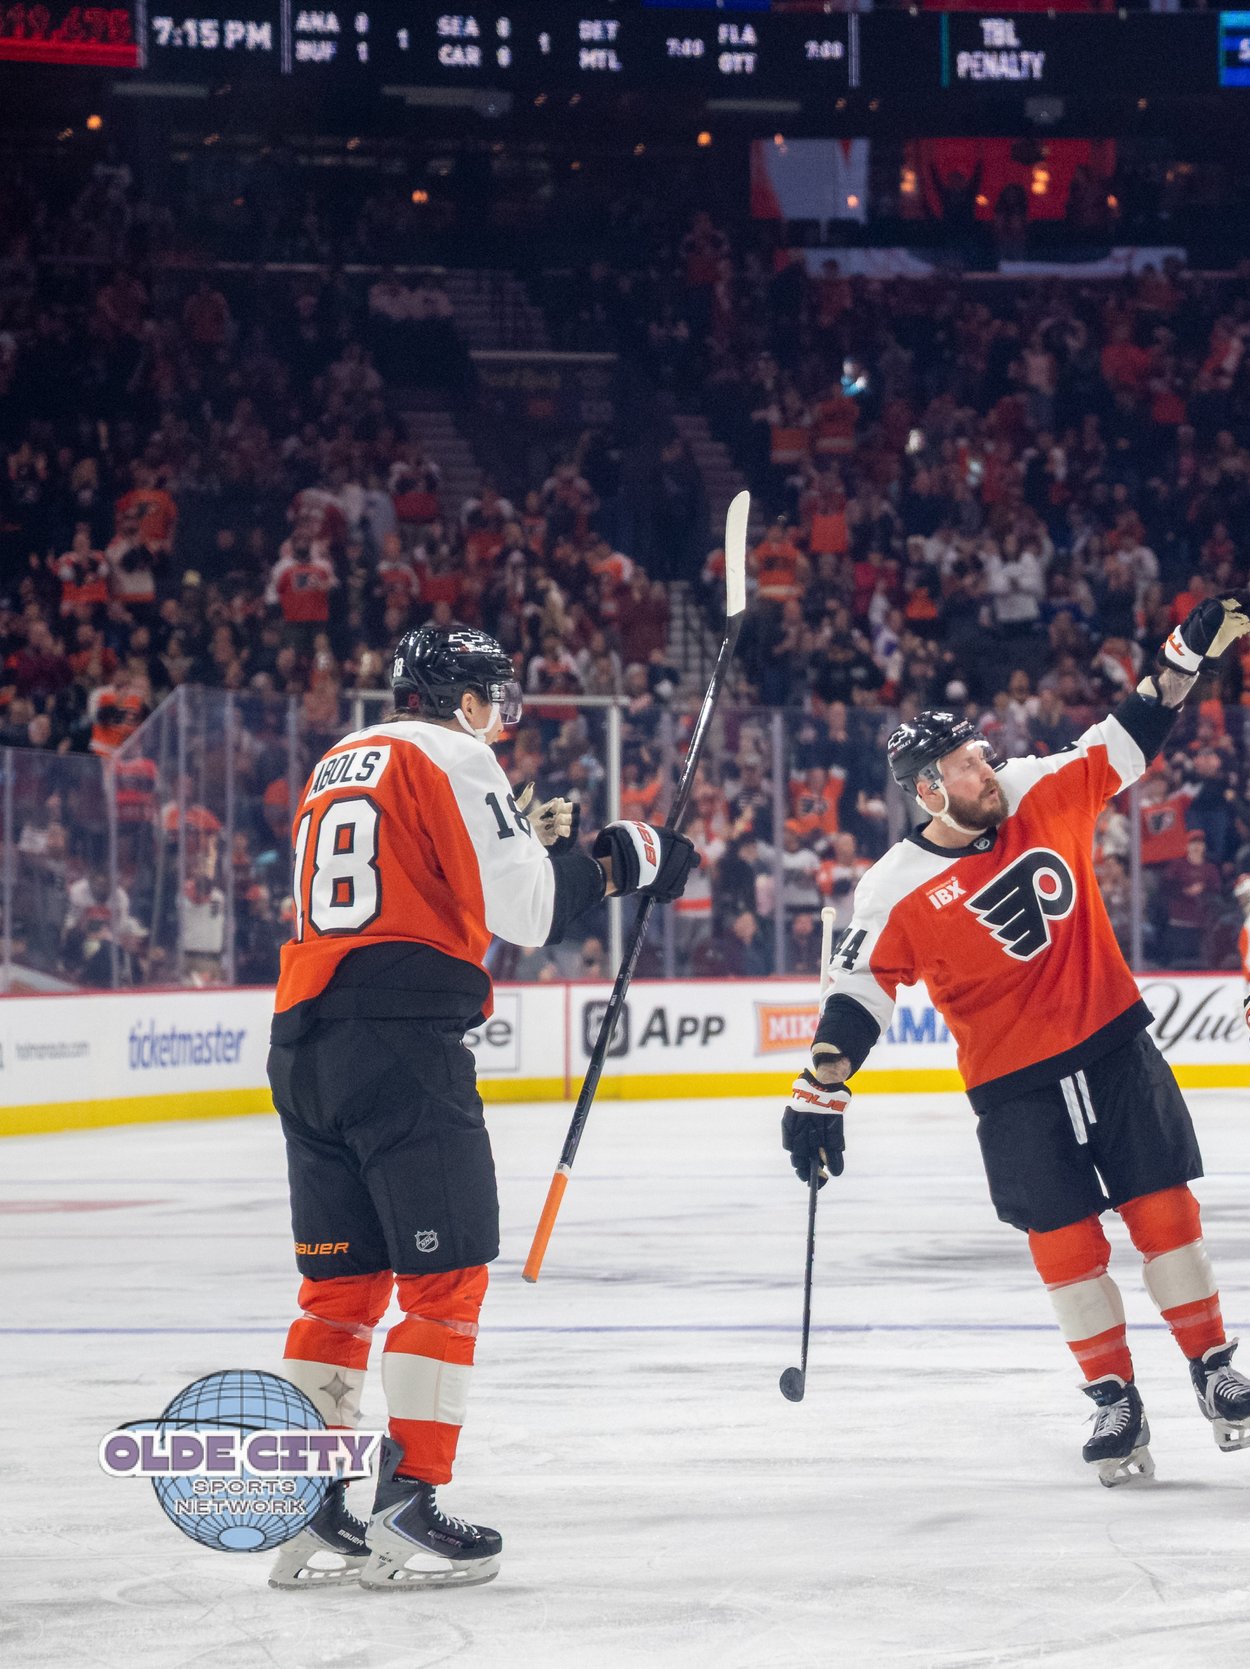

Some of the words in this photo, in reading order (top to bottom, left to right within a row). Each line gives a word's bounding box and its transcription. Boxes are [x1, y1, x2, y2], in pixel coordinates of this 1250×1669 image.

[153, 17, 219, 49] 7:15
[224, 21, 272, 50] PM
[436, 15, 480, 37] SEA
[718, 23, 757, 45] FLA
[979, 18, 1020, 48] TBL
[397, 28, 409, 50] 1
[356, 41, 369, 63] 1
[437, 44, 481, 67] CAR
[718, 52, 757, 74] OTT
[956, 51, 1046, 80] PENALTY
[309, 751, 382, 797] ABOLS
[292, 793, 384, 943] 18
[928, 879, 968, 910] IBX
[127, 1017, 247, 1070] ticketmaster
[792, 1087, 847, 1112] TRUE
[337, 1528, 365, 1547] BAUER
